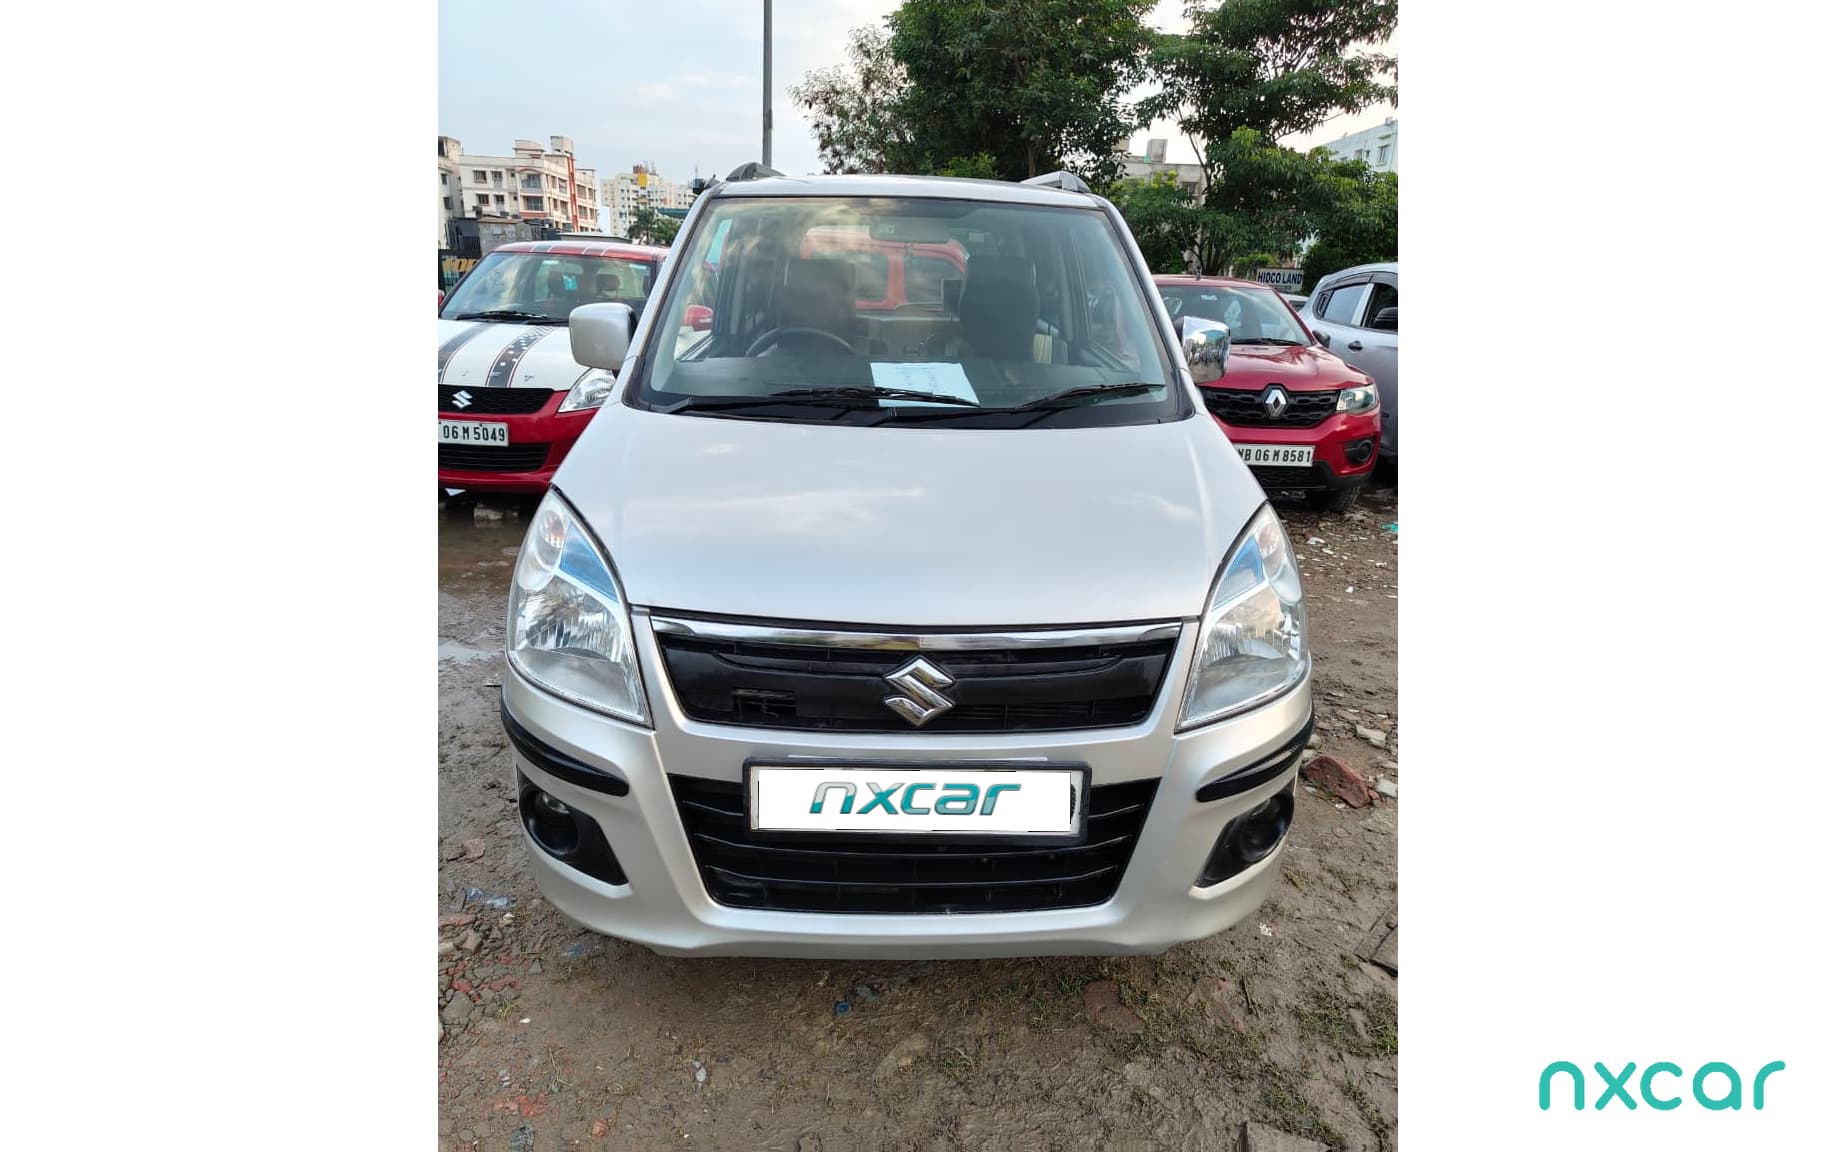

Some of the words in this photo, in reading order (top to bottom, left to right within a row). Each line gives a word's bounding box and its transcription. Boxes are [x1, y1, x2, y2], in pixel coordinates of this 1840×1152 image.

[1258, 272, 1281, 284] HIDCO
[1282, 272, 1302, 285] LAND
[444, 425, 459, 440] 06
[462, 426, 470, 440] M
[473, 426, 506, 442] 5049
[1255, 449, 1270, 462] 06
[1273, 449, 1281, 462] M
[1282, 450, 1312, 463] 8581
